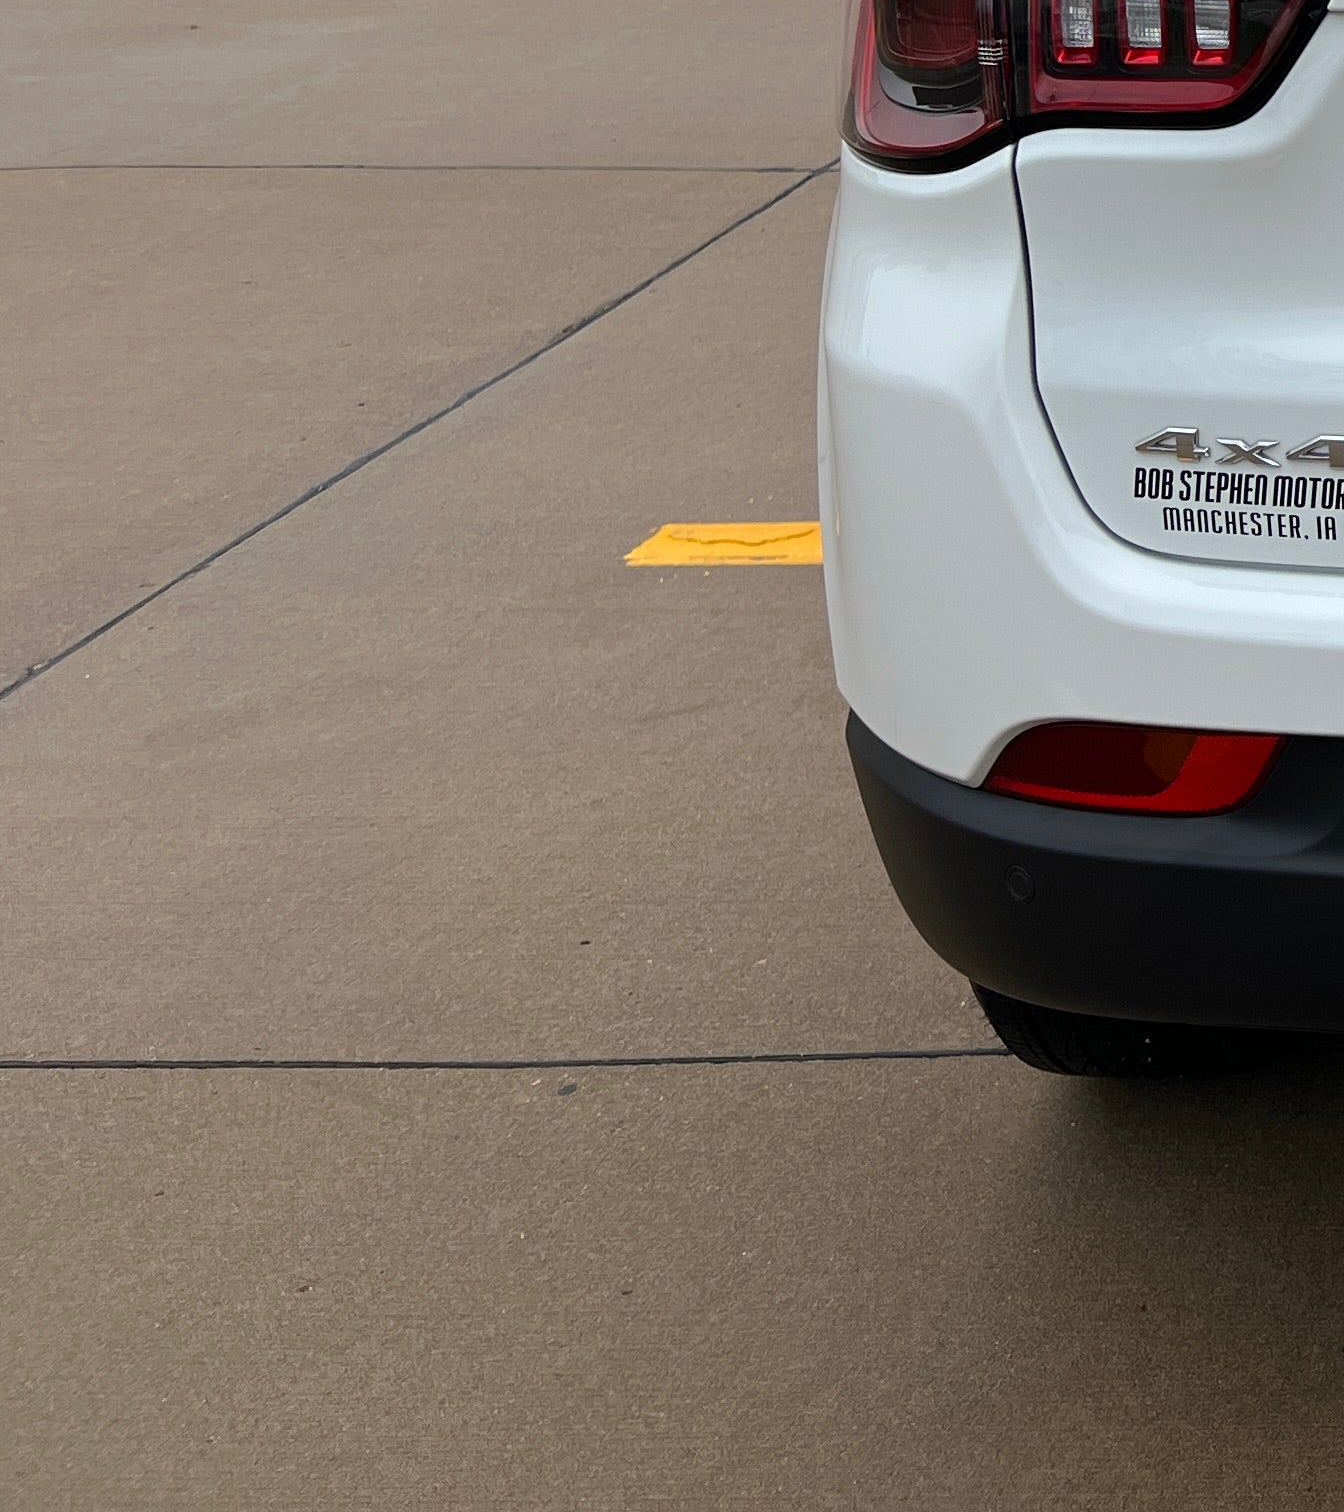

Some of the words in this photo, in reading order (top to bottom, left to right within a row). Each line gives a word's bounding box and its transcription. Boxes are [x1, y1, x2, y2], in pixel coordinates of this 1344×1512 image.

[1134, 467, 1174, 499] BOB
[1178, 470, 1268, 506] STEPHEN
[1162, 506, 1309, 540] MANCHESTER,
[1316, 516, 1337, 540] IA
